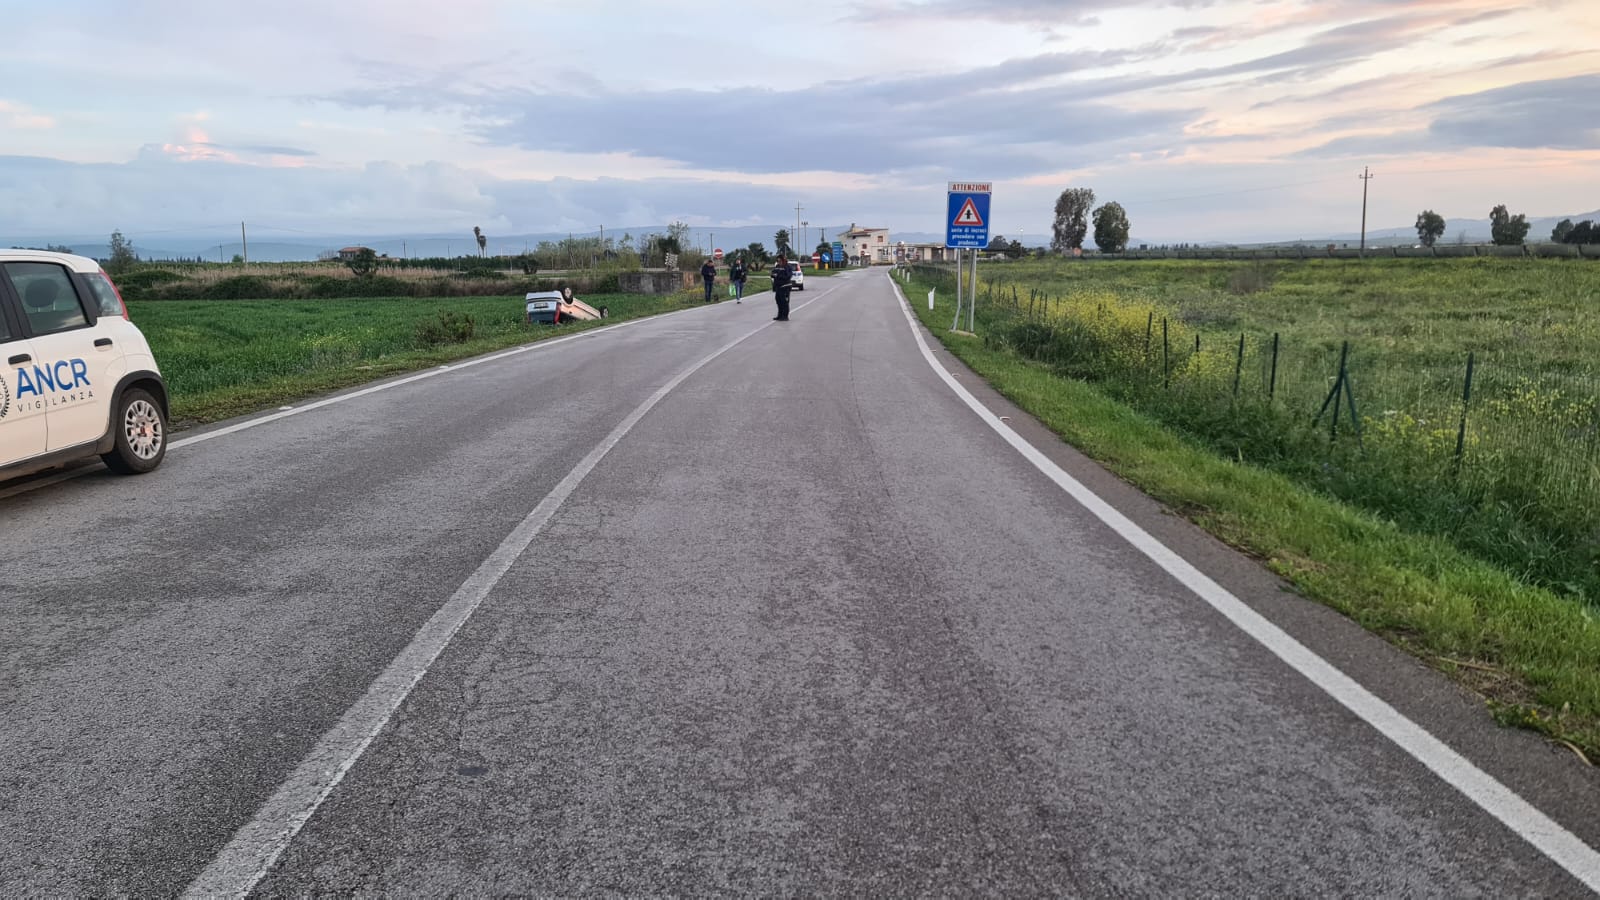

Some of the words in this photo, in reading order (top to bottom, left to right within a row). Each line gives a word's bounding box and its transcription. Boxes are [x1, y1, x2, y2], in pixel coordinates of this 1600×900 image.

[952, 183, 989, 191] ATTENZIONE
[16, 358, 91, 399] ANCR
[17, 390, 94, 413] VIGILANZA
